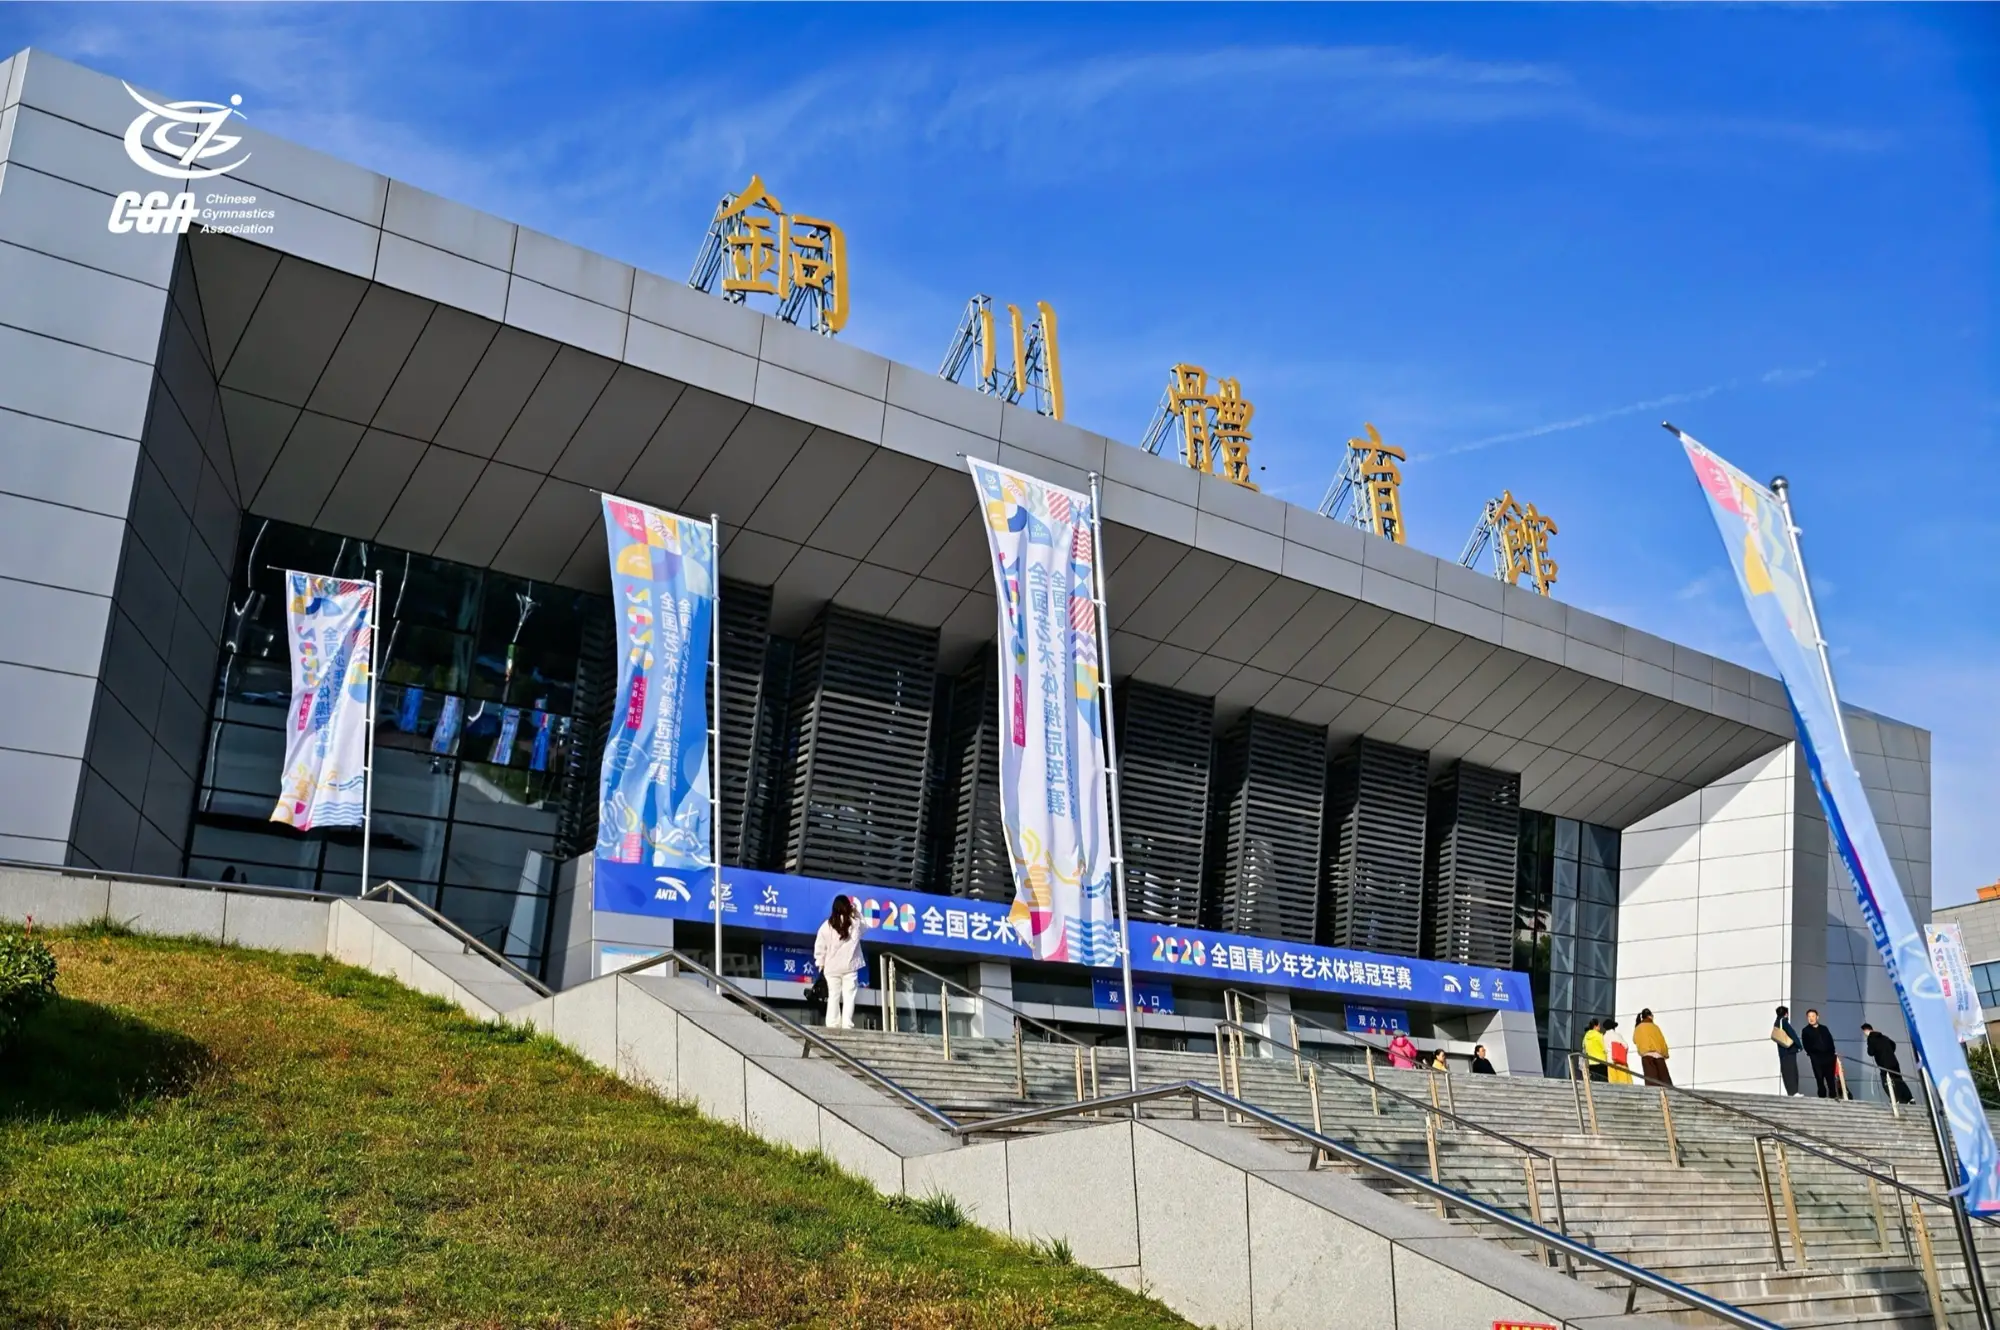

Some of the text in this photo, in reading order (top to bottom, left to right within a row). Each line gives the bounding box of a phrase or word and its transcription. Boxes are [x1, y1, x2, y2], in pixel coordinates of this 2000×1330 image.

[655, 888, 678, 902] ANTA
[921, 905, 1027, 946] 全国艺术
[1152, 935, 1206, 966] 2026
[1210, 942, 1412, 990] 全国青少年艺术体操冠军赛
[1109, 991, 1160, 1007] 观入口
[1358, 1015, 1398, 1029] 观众入口
